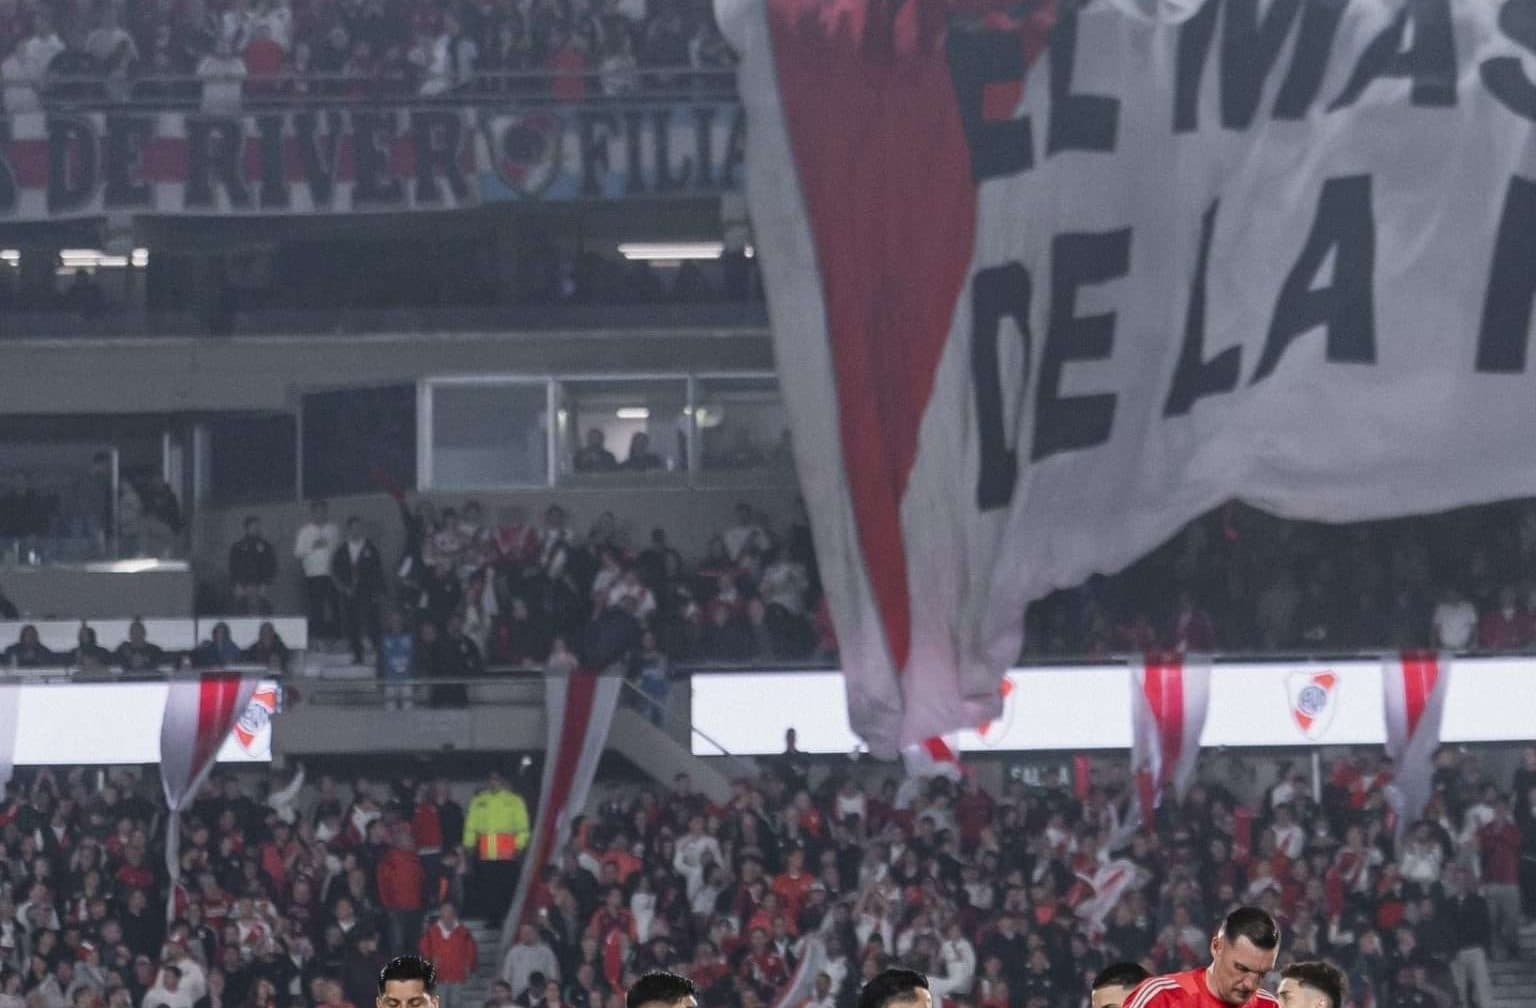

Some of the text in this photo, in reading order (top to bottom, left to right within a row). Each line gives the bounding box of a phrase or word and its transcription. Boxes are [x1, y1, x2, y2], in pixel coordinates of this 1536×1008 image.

[186, 105, 477, 206] RIVER
[946, 0, 1121, 183] EL
[971, 226, 1132, 512] DE
[1162, 174, 1378, 418] LA
